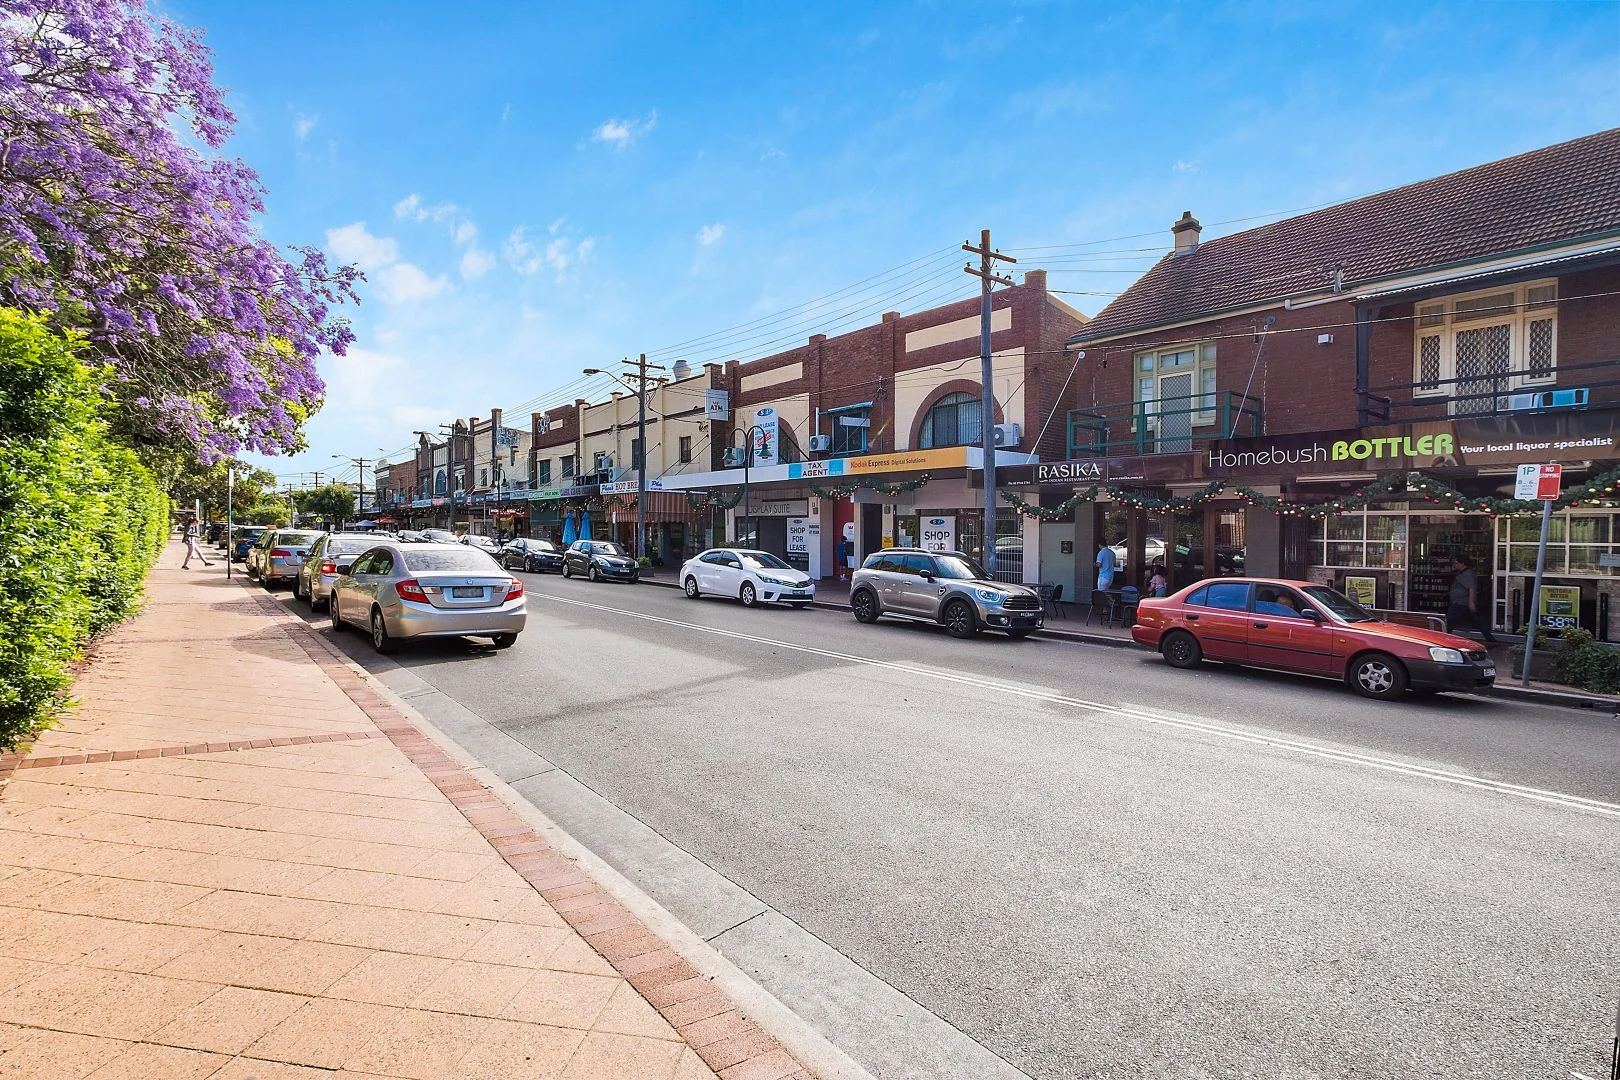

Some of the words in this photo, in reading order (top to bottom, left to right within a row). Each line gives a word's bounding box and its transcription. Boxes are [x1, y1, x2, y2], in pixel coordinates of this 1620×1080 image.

[1209, 442, 1327, 468] Homebush
[1331, 433, 1453, 461] BOTTLER
[1460, 445, 1485, 455] Your
[1487, 443, 1515, 453] local
[1516, 442, 1551, 454] liquor
[1553, 437, 1613, 452] specialist
[808, 462, 822, 470] TAX
[850, 461, 868, 471] Kodak
[868, 459, 890, 470] Express
[891, 459, 906, 468] Digital
[905, 457, 926, 466] Solutions
[802, 469, 829, 478] AGENT
[1038, 462, 1101, 479] RASIKA
[1522, 466, 1536, 475] 1P
[774, 503, 790, 514] SUITE
[792, 535, 804, 543] FOR
[924, 531, 950, 540] SHOP
[927, 542, 946, 551] FOR
